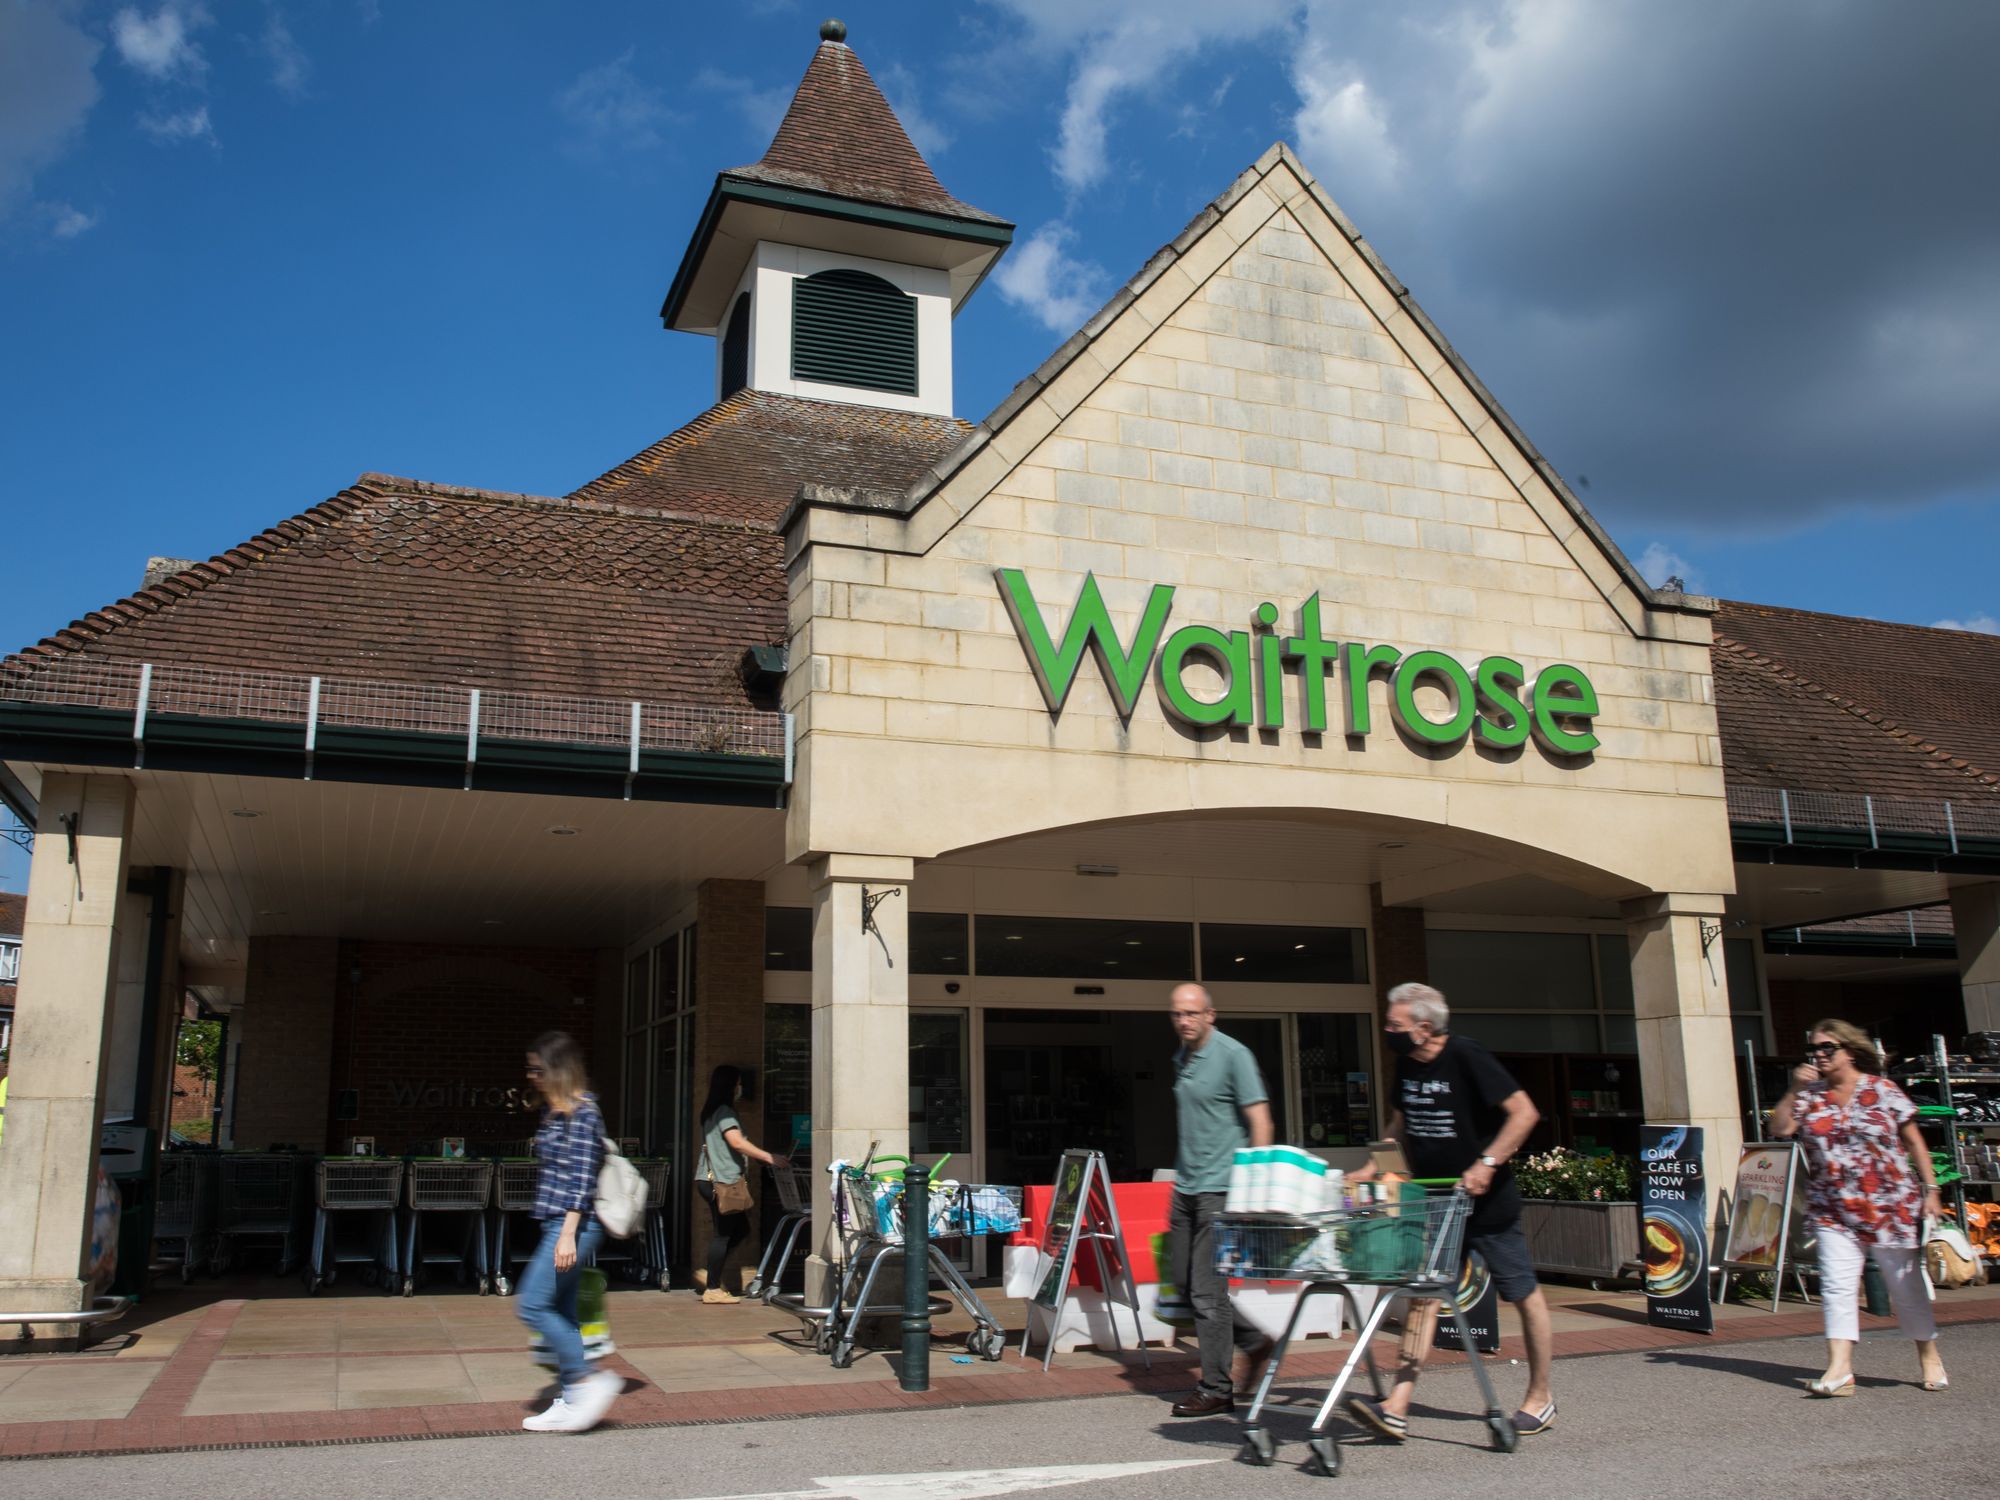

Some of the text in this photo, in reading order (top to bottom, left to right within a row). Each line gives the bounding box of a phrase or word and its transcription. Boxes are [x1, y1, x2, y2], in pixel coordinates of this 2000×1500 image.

[994, 567, 1601, 756] Waitrose
[1648, 1148, 1677, 1160] OUR
[1648, 1162, 1697, 1174] CAFÉ IS
[1648, 1175, 1684, 1186] NOW
[1742, 1173, 1785, 1185] SPARKLING
[1649, 1188, 1686, 1201] OPEN
[1656, 1306, 1700, 1317] WAITROSE
[1440, 1326, 1488, 1335] WAIOSE
